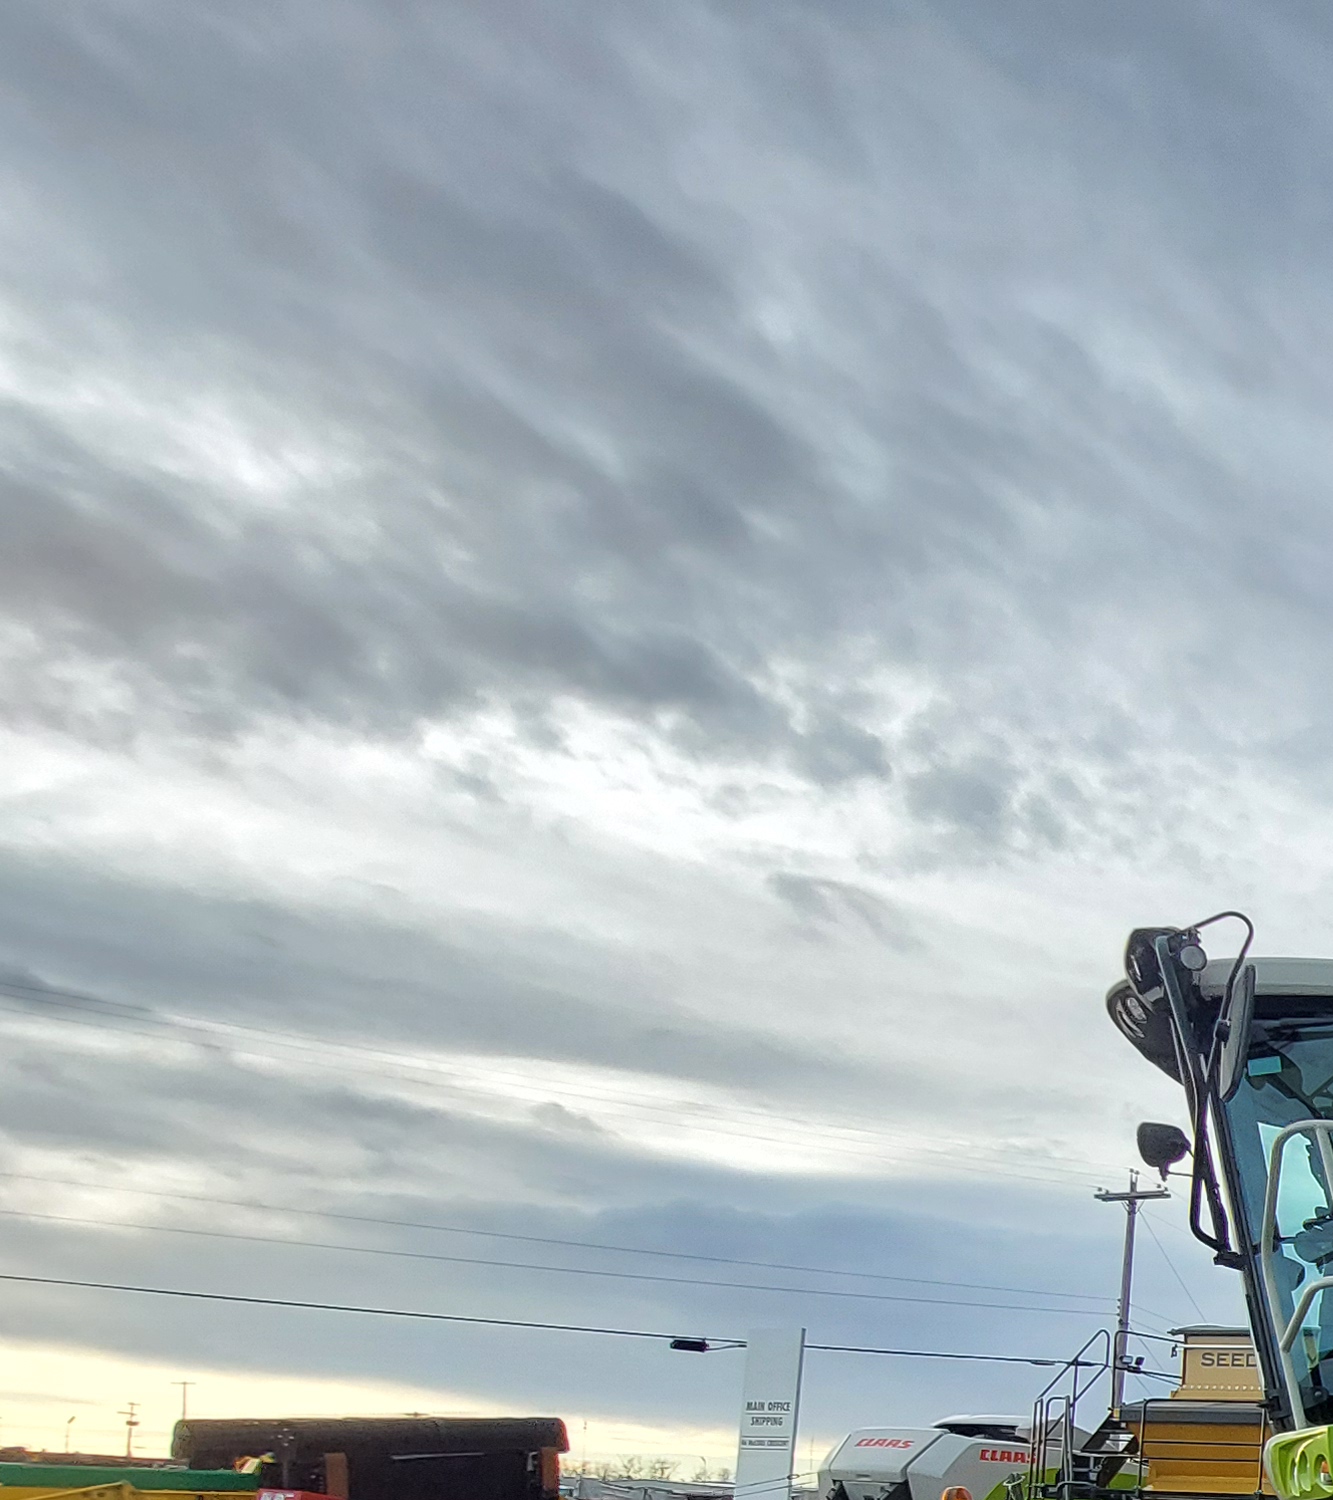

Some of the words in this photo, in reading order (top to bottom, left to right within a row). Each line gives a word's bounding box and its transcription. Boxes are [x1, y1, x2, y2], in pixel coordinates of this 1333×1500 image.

[746, 1401, 766, 1411] MAIN
[767, 1401, 791, 1411] OFFICE
[855, 1438, 915, 1450] CLAAS
